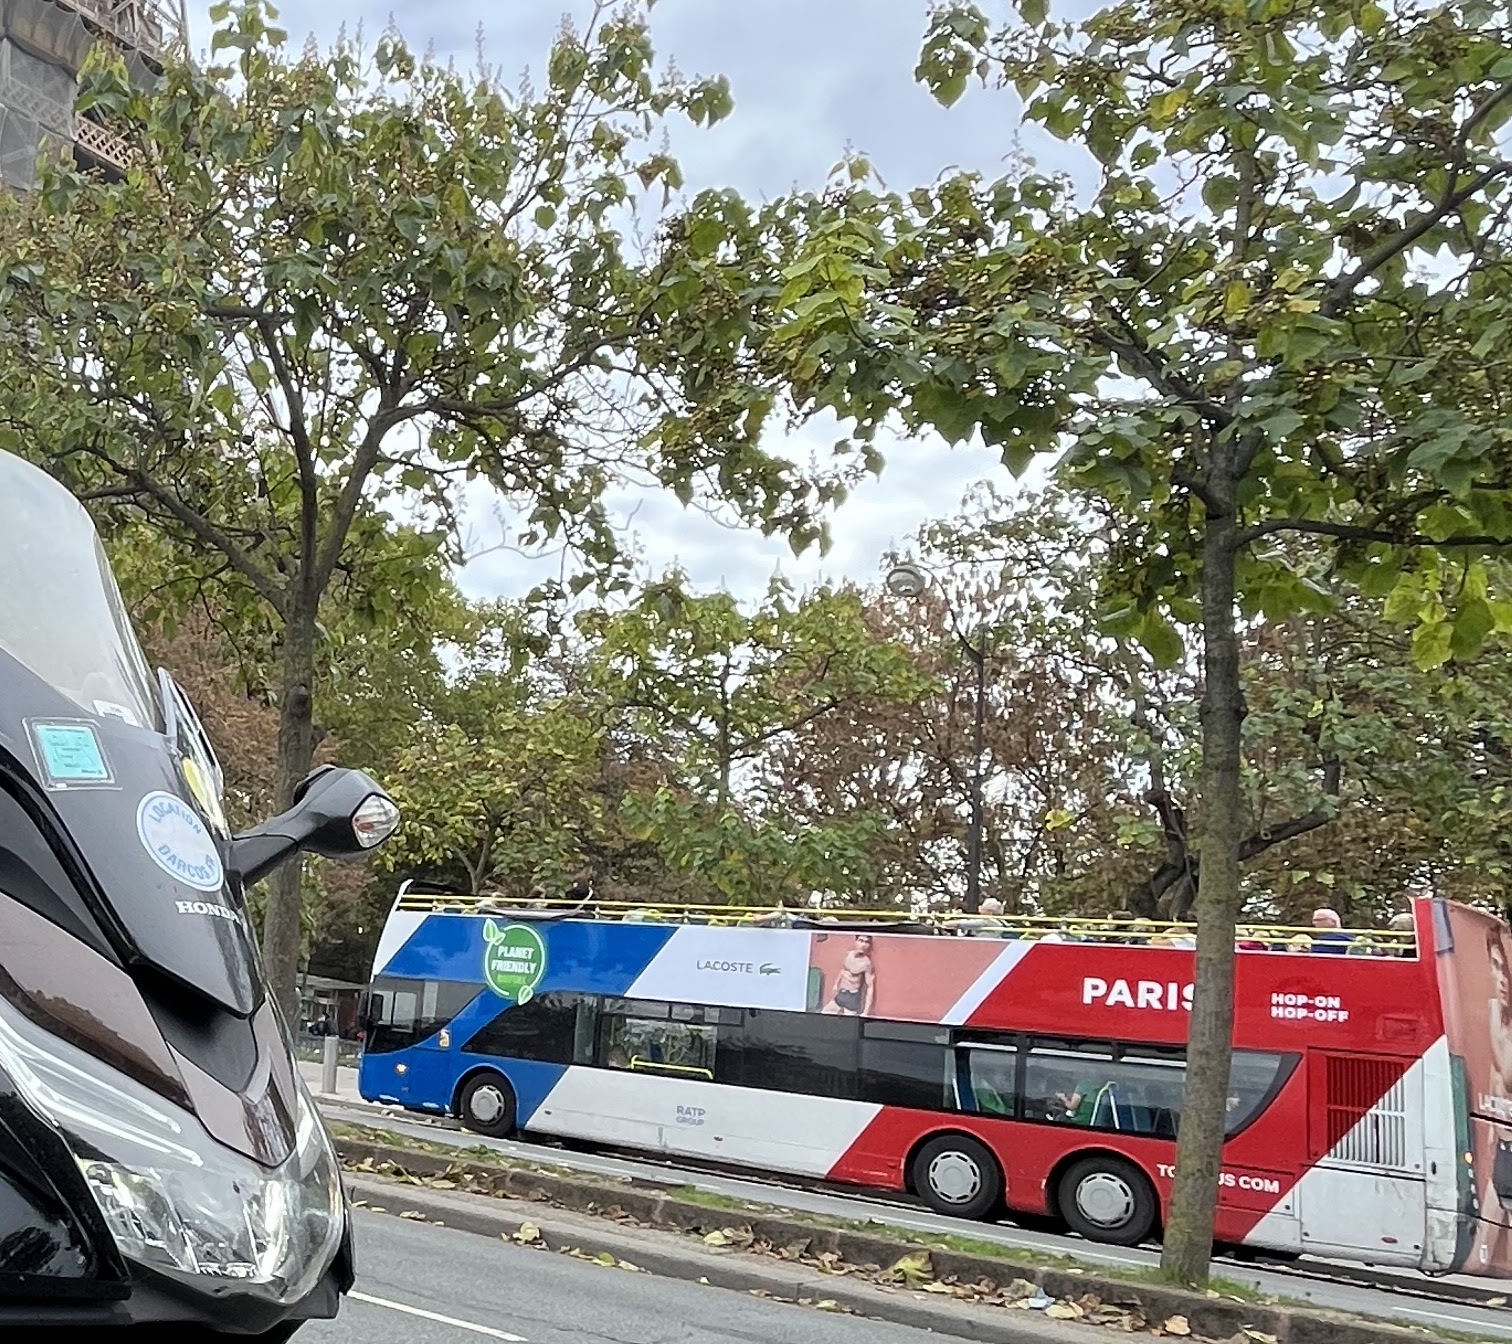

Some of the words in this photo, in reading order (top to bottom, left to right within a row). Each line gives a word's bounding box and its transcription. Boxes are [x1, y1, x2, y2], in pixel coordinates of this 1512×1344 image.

[148, 801, 202, 834] LOCATION
[175, 900, 242, 926] HONDA
[497, 945, 536, 960] PLANET
[491, 959, 537, 974] FRIENDLY
[696, 959, 754, 974] LACOSTE
[1271, 992, 1341, 1009] HOP-ON
[1270, 1006, 1349, 1023] HOP-OFF
[676, 1105, 706, 1117] RATP
